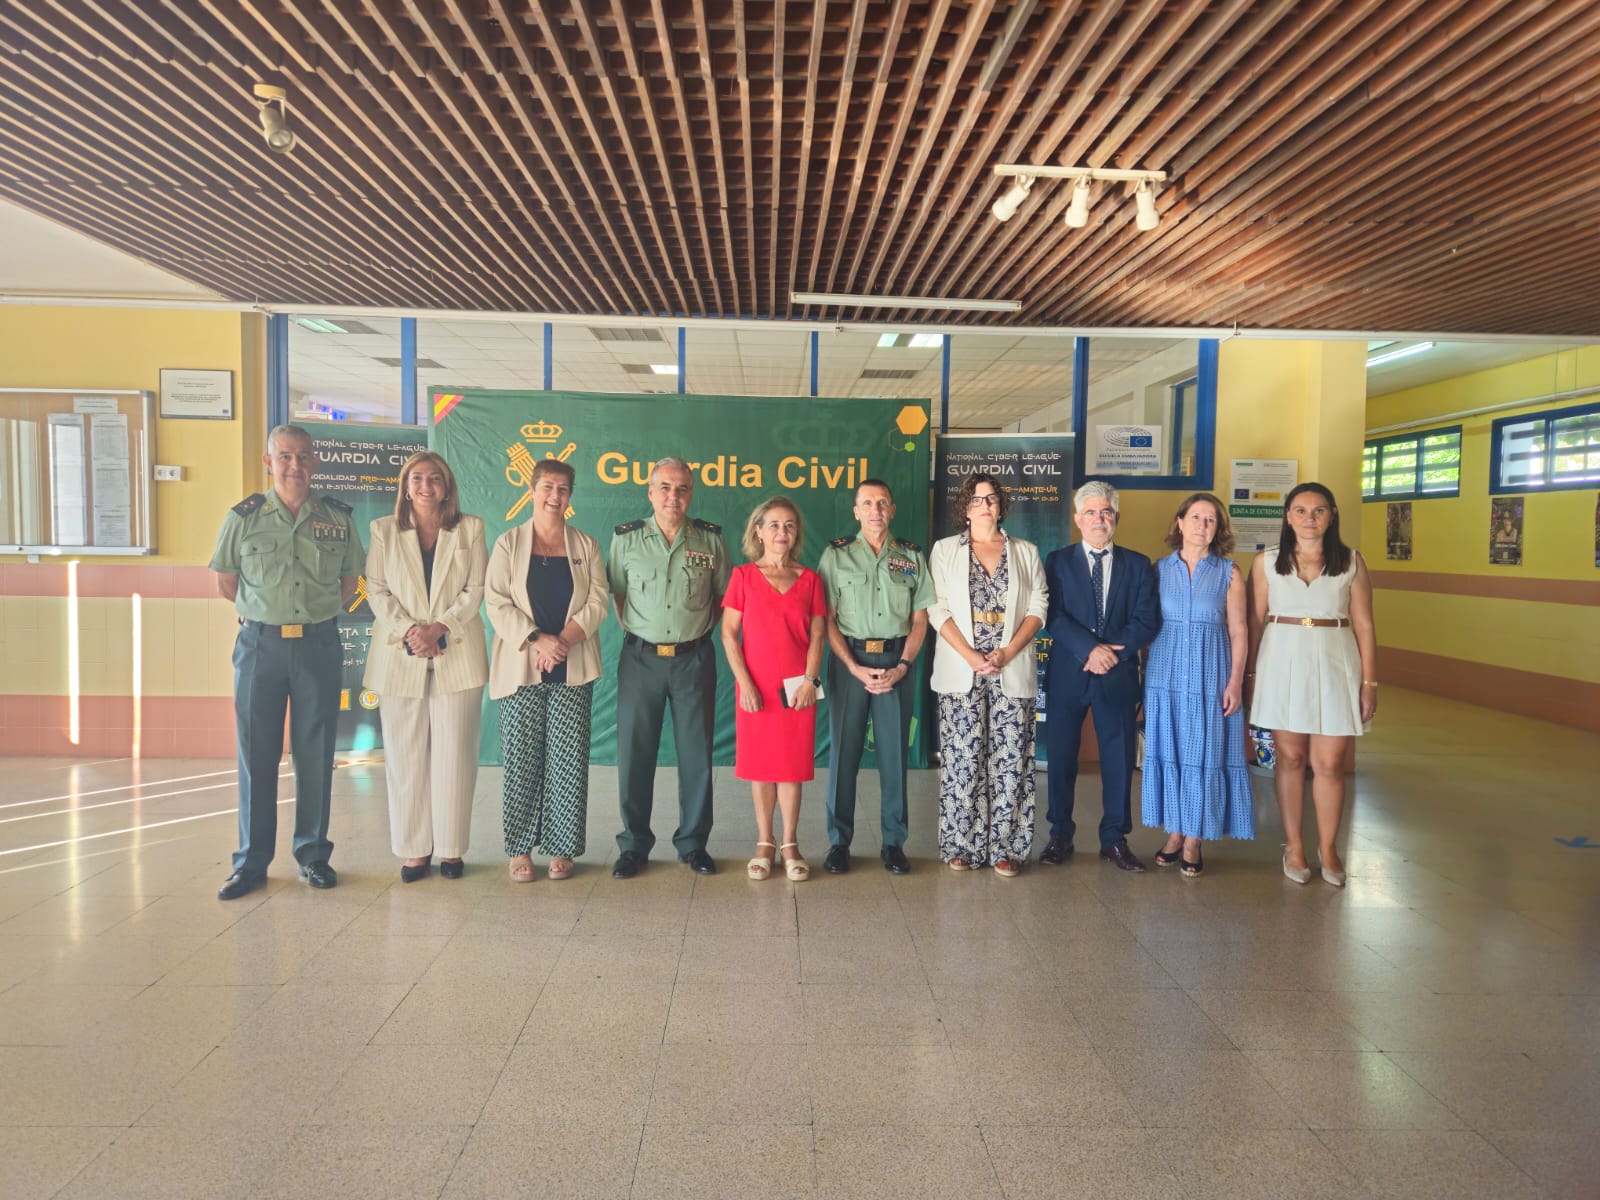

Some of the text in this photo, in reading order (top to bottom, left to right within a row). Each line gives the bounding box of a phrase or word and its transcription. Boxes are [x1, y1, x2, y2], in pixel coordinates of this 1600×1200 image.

[350, 441, 384, 451] CYBER
[387, 443, 427, 453] LEAGUE
[314, 451, 380, 464] UARDIA
[946, 451, 1061, 461] NATIONAL CYBER LEAGUE
[597, 452, 868, 489] Gurdia Civil
[947, 464, 1062, 476] GUARDIA CIVIL
[326, 483, 382, 492] ESTUDIANTES
